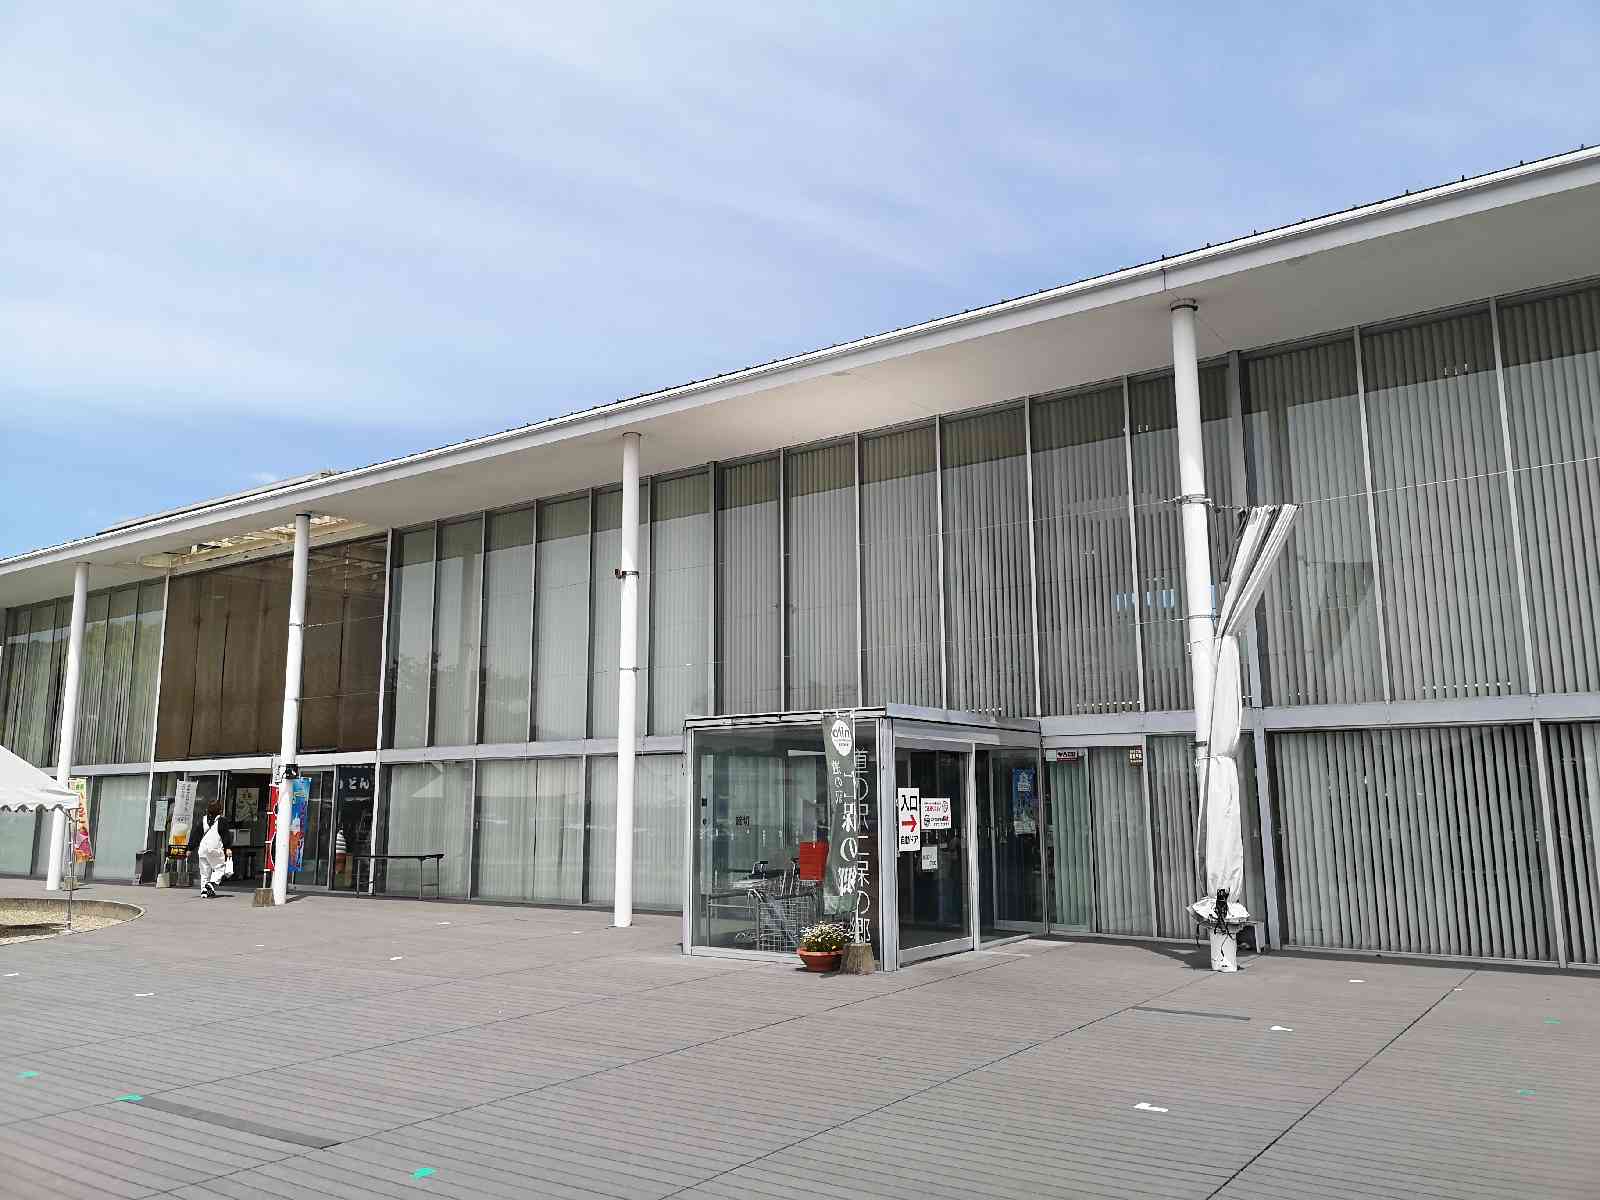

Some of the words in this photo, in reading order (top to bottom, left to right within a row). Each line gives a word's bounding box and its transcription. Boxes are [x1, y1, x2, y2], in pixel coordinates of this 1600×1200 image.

[900, 795, 918, 811] 入口
[900, 835, 918, 845] 自動ドア
